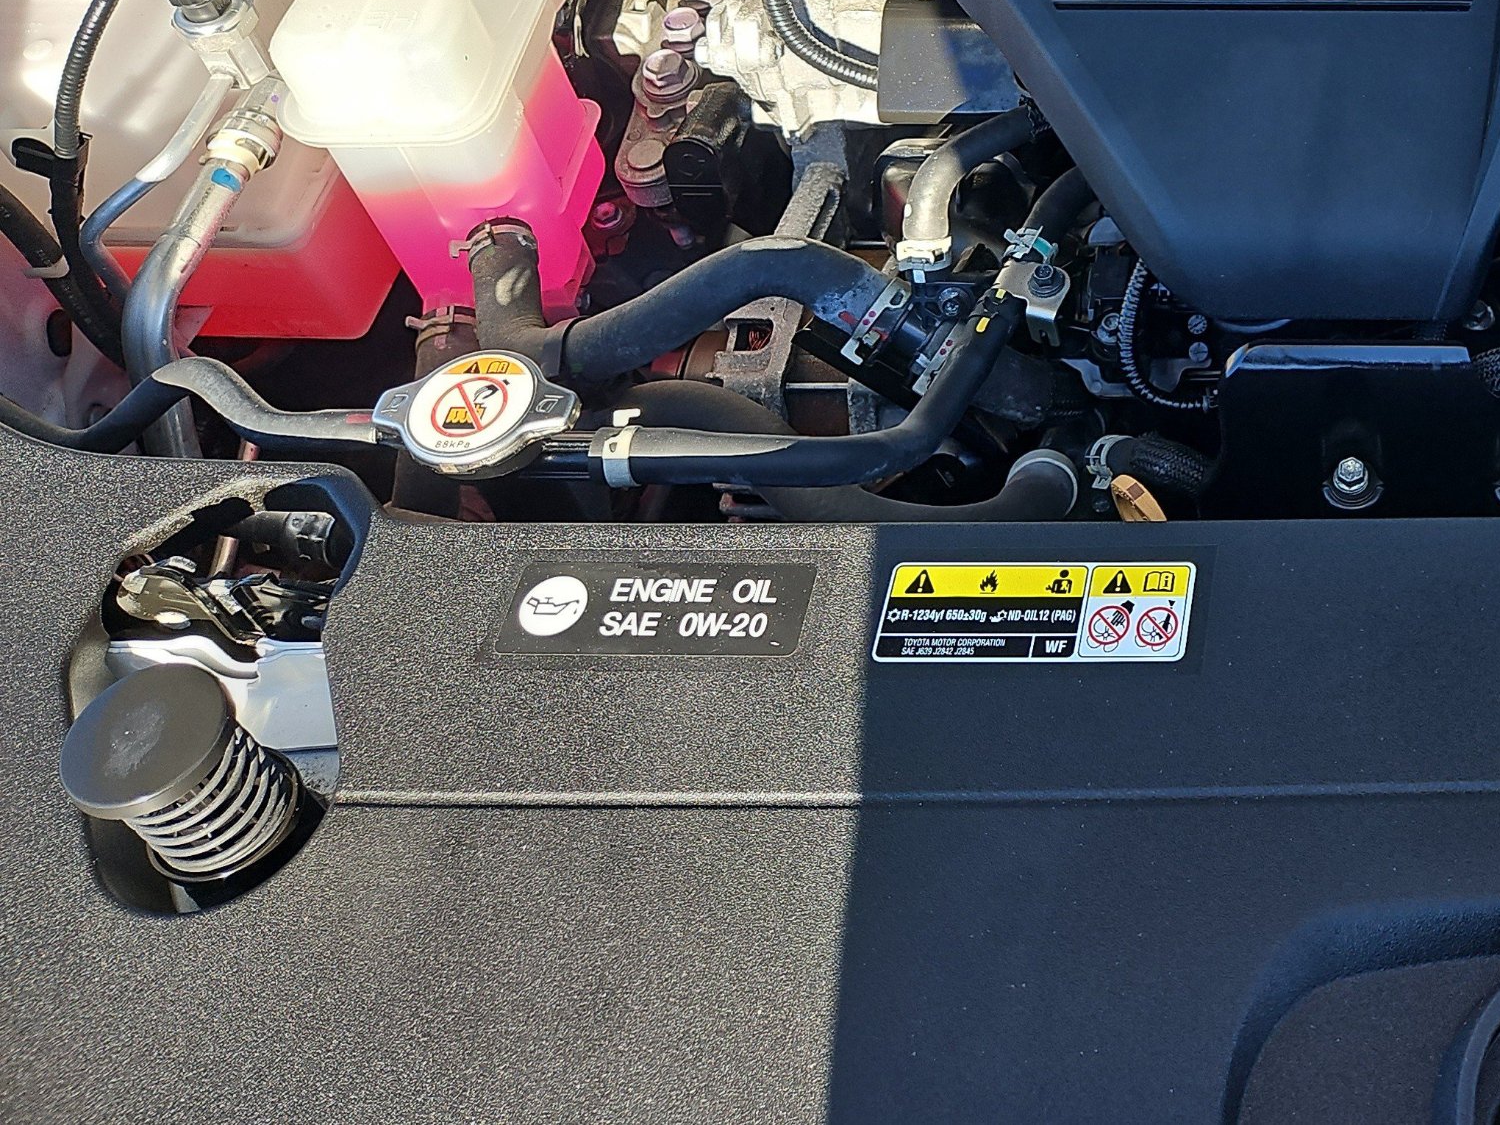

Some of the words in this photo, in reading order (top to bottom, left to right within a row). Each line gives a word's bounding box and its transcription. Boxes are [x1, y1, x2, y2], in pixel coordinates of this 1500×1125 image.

[609, 578, 717, 603] ENGINE
[732, 579, 777, 604] OIL
[900, 609, 945, 623] R-1234yf
[945, 609, 987, 623] 650±30g
[1050, 609, 1077, 624] (PAG)
[599, 612, 661, 637] SAE
[678, 612, 768, 637] 0W-20
[904, 638, 930, 647] TOYOTA
[930, 638, 956, 647] MOTOR
[957, 638, 1006, 647] CORPORATION
[1044, 639, 1068, 654] WF
[900, 647, 915, 655] SAE
[915, 647, 932, 655] J639
[932, 647, 953, 655] J2842
[954, 646, 975, 655] J2845
